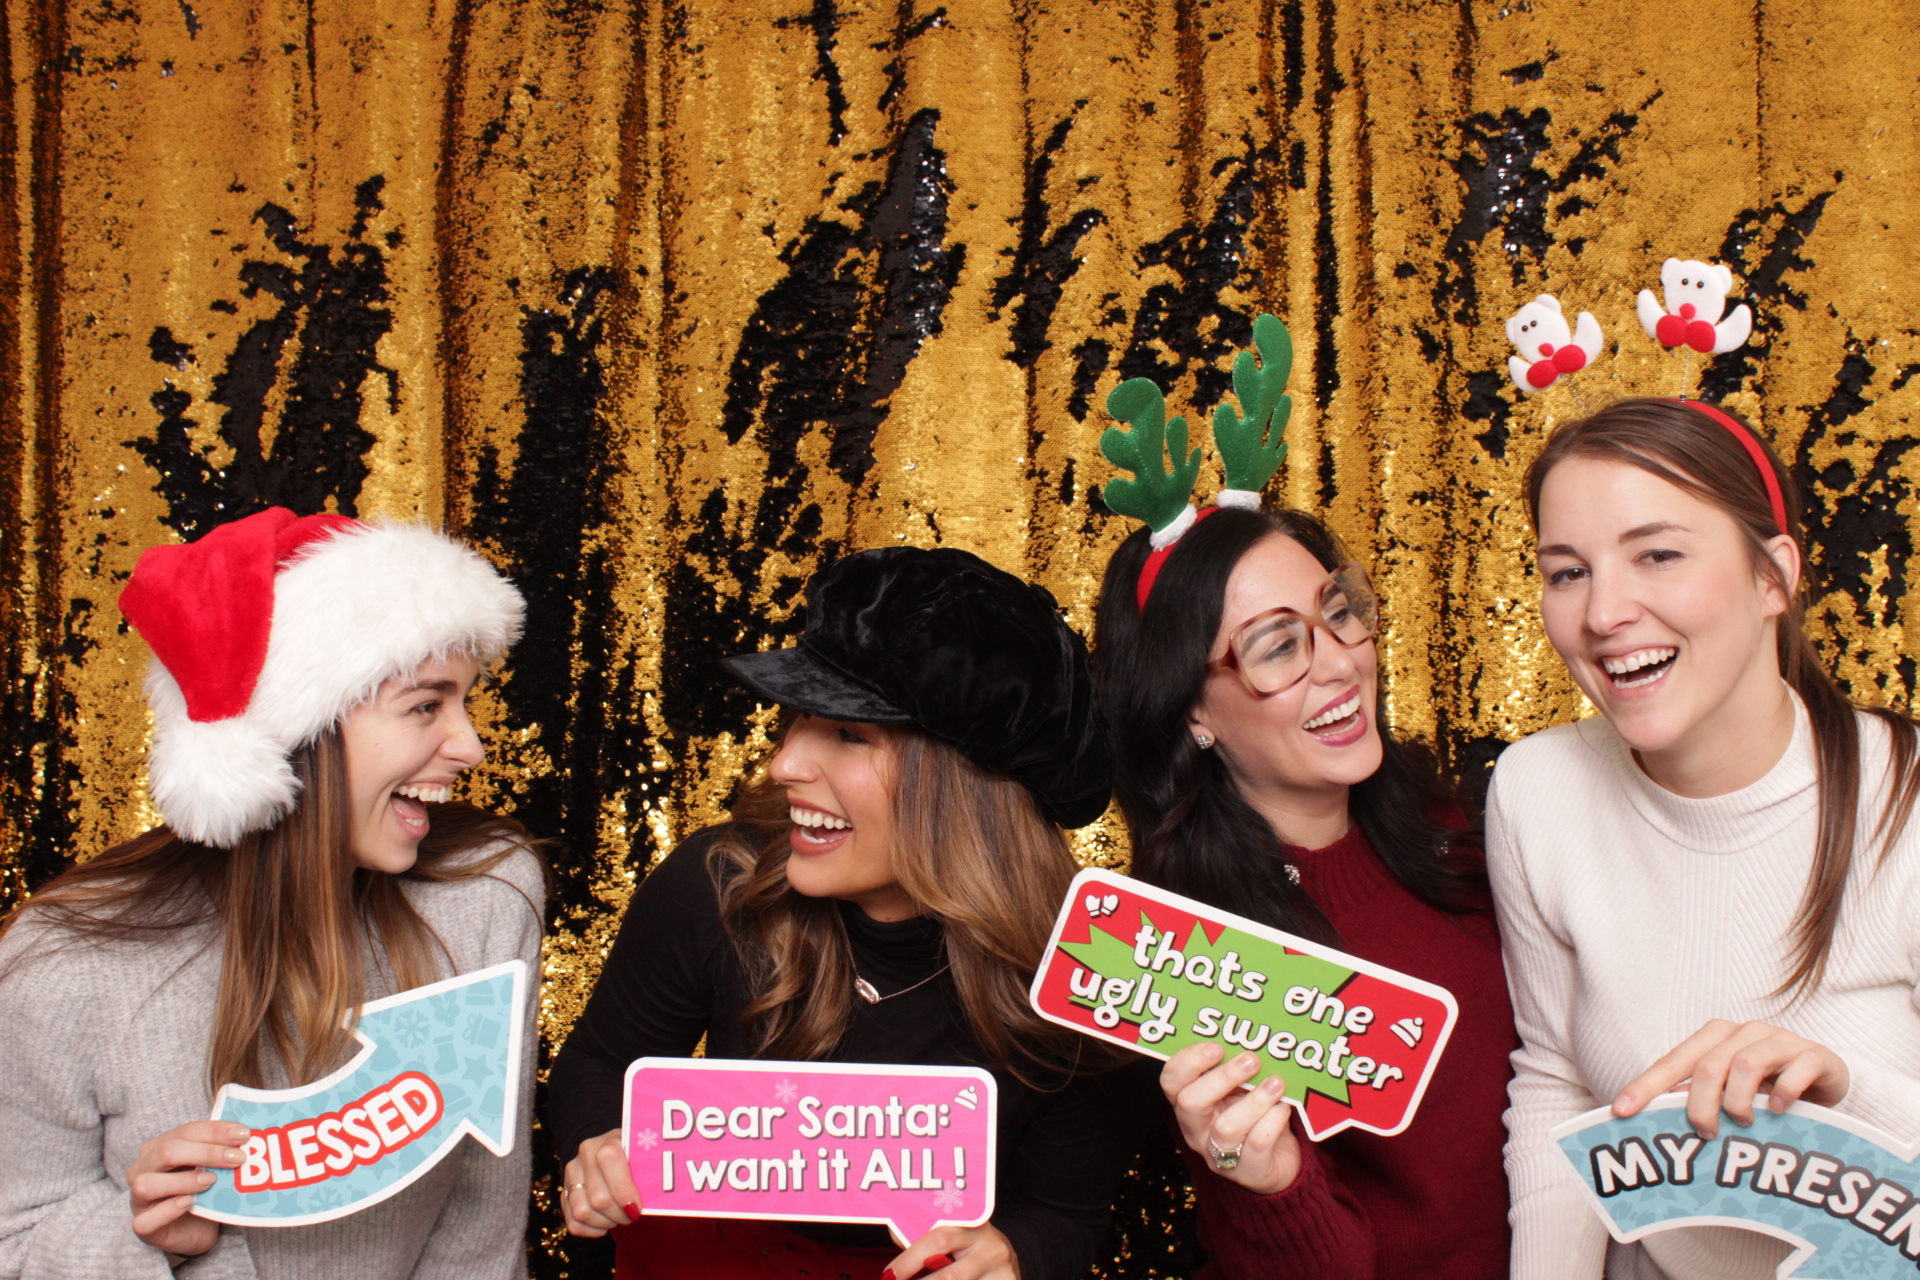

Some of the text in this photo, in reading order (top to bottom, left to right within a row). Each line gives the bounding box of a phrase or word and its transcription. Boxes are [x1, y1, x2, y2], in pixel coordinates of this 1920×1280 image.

[1133, 923, 1269, 1001] thats
[1283, 984, 1375, 1035] one
[1068, 966, 1404, 1091] ugly sweater
[239, 1077, 438, 1187] BLESSED
[661, 1099, 787, 1140] Dear
[797, 1095, 952, 1139] Santa:
[661, 1150, 674, 1192] I
[685, 1148, 807, 1191] want
[816, 1147, 850, 1190] it
[1596, 1137, 1701, 1194] MY
